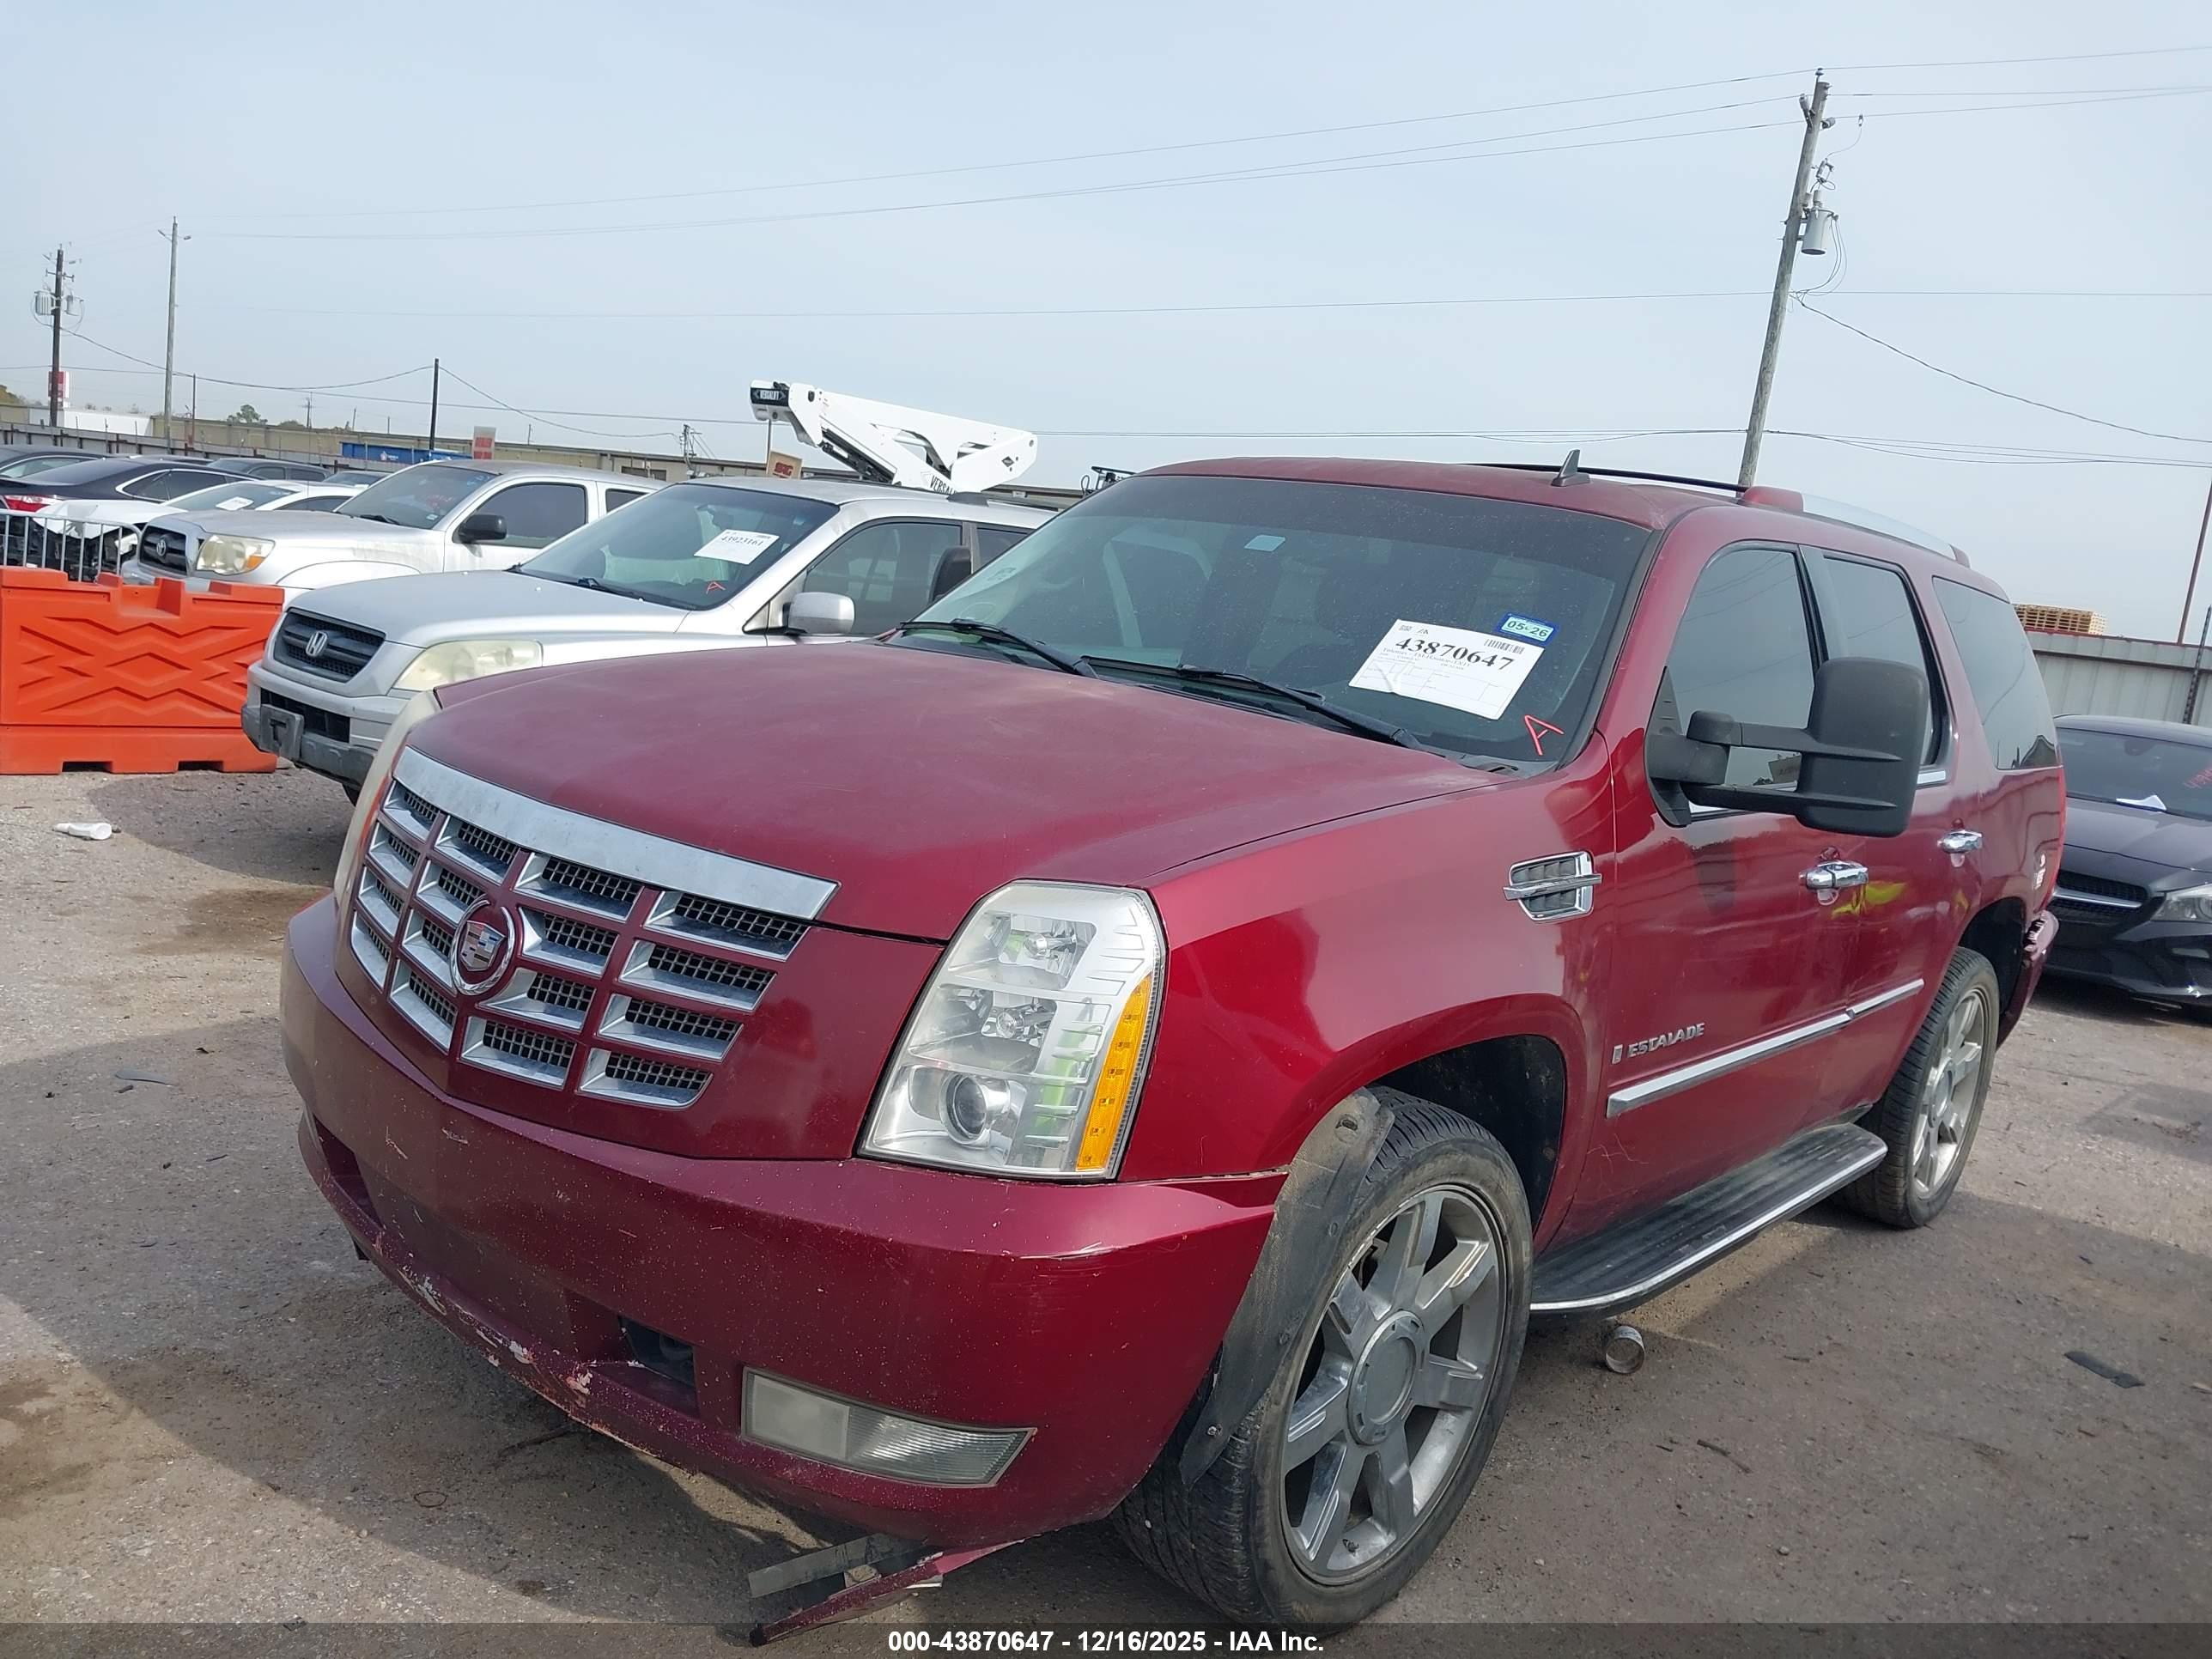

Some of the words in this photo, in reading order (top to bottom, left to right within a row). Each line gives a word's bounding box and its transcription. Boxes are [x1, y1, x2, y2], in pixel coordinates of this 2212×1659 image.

[1395, 638, 1514, 670] 43870647
[1524, 714, 1565, 756] A
[1627, 1022, 1705, 1058] ESCALADE
